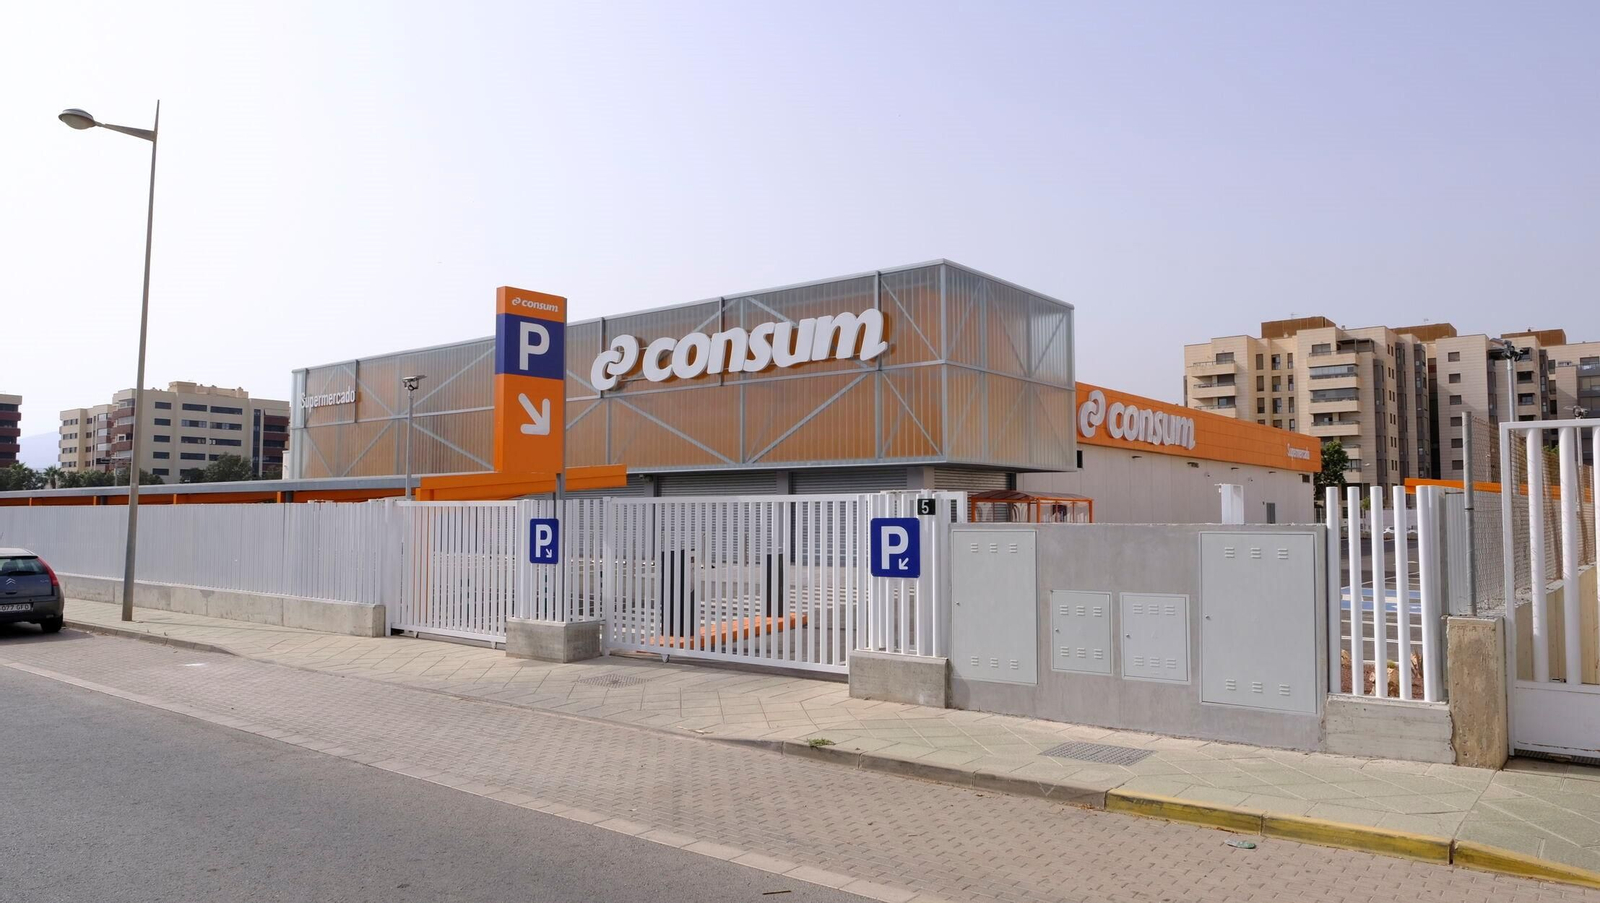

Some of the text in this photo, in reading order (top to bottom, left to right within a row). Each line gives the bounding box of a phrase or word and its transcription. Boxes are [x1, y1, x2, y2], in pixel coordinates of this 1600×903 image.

[521, 300, 559, 313] consum
[519, 320, 551, 371] P
[642, 308, 888, 382] consum
[301, 386, 355, 412] Supermercado
[1107, 402, 1195, 450] consum
[921, 500, 930, 514] 5
[535, 524, 553, 558] P
[880, 525, 909, 570] P
